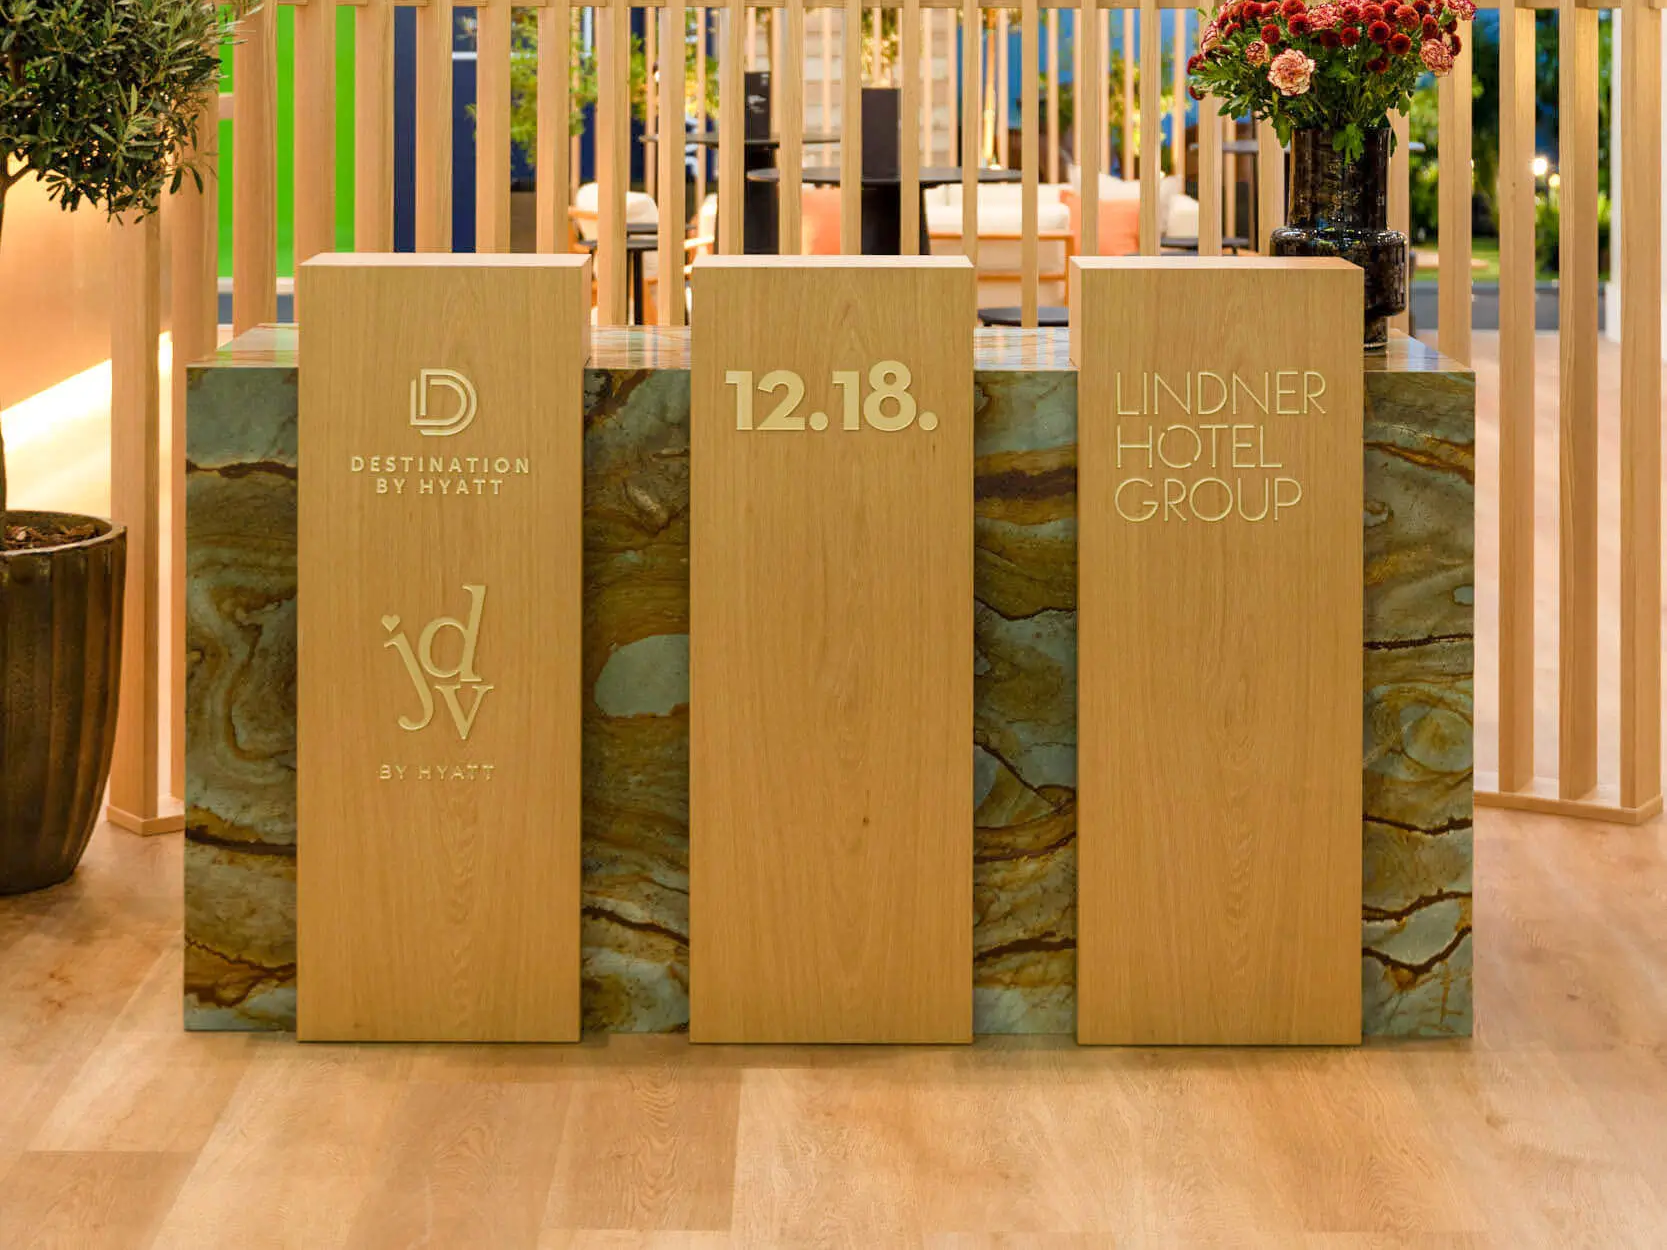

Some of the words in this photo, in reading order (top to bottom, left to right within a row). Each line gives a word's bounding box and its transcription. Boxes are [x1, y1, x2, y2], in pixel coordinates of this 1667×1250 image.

[724, 360, 939, 432] 12.18.
[1115, 370, 1327, 415] LINDNER
[351, 455, 530, 474] DESTINATION
[1115, 424, 1283, 469] HOTEL
[375, 477, 406, 495] BY
[419, 478, 504, 495] HYATT
[1114, 477, 1303, 522] GROUP
[379, 764, 408, 780] BY
[417, 764, 495, 781] HYATT
